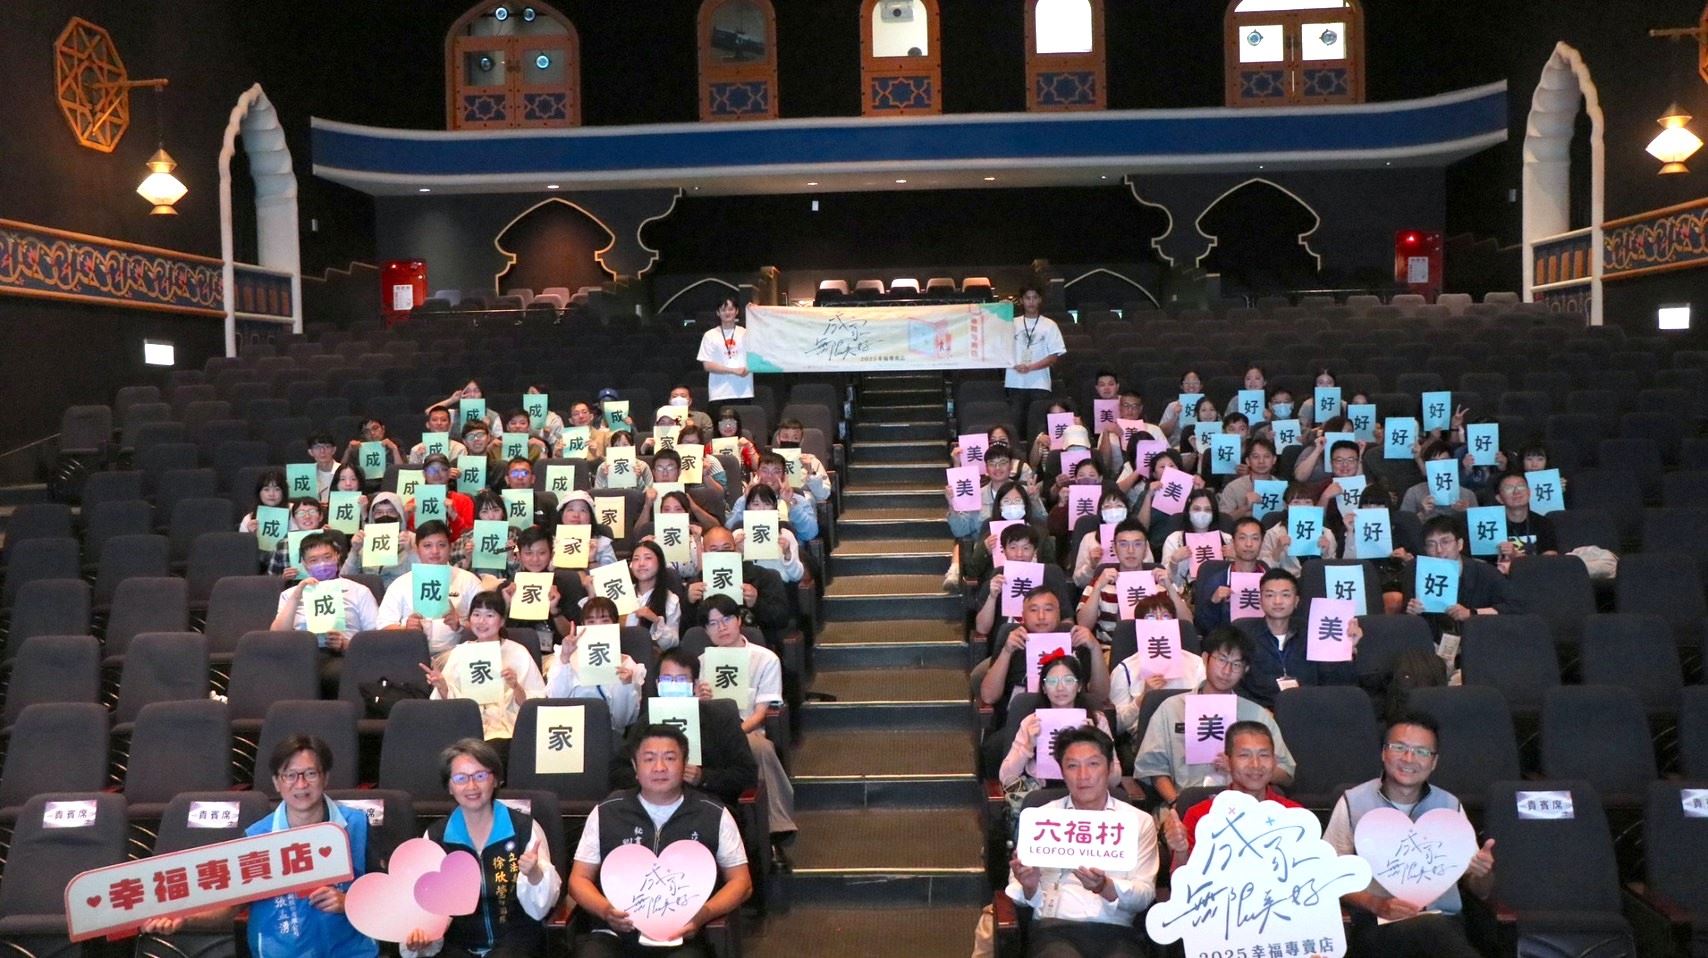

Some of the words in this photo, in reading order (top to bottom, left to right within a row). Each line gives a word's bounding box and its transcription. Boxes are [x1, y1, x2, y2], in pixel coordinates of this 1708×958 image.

[529, 404, 543, 418] 成
[1244, 401, 1259, 415] 好
[1320, 397, 1335, 411] 好
[1429, 402, 1445, 418] 好
[466, 409, 480, 421] 成
[611, 410, 624, 423] 成
[1100, 409, 1114, 423] 美
[1355, 415, 1370, 430] 好
[569, 436, 585, 451] 成
[660, 436, 674, 449] 家
[1280, 429, 1295, 443] 好
[1391, 429, 1409, 446] 好
[1475, 435, 1492, 452] 好
[508, 443, 522, 457] 成
[966, 445, 983, 462] 美
[1218, 446, 1234, 461] 好
[366, 452, 380, 466] 成
[613, 457, 630, 474] 家
[681, 455, 696, 470] 家
[294, 475, 310, 492] 成
[464, 467, 479, 483] 成
[552, 476, 567, 491] 成
[1435, 472, 1453, 490] 好
[956, 479, 974, 497] 美
[1163, 481, 1184, 502] 美
[1535, 483, 1554, 501] 好
[422, 497, 439, 514] 成
[1261, 493, 1279, 510] 好
[1343, 489, 1361, 505] 好
[336, 503, 354, 520] 成
[510, 500, 527, 517] 成
[1076, 498, 1095, 515] 美
[601, 509, 618, 526] 家
[262, 520, 280, 537] 成
[662, 526, 681, 546] 家
[752, 524, 771, 543] 家
[1296, 520, 1315, 540] 好
[1364, 523, 1383, 542] 好
[1477, 521, 1498, 541] 好
[371, 534, 390, 552] 成
[481, 534, 500, 553] 成
[563, 538, 582, 555] 家
[1195, 544, 1215, 563] 美
[712, 568, 734, 589] 家
[1425, 573, 1448, 597] 好
[420, 580, 442, 601] 成
[521, 583, 542, 604] 家
[603, 578, 626, 601] 家
[1011, 577, 1032, 598] 美
[1335, 580, 1356, 600] 好
[314, 595, 336, 616] 成
[1240, 588, 1260, 609] 美
[1319, 616, 1343, 641] 美
[587, 641, 611, 666] 家
[1148, 636, 1172, 660] 美
[469, 659, 494, 684] 家
[715, 664, 738, 689] 家
[1197, 714, 1224, 741] 美
[548, 724, 573, 751] 家
[1033, 819, 1125, 846] 六福村
[1029, 847, 1075, 858] LEOFOO
[1079, 849, 1125, 858] VILLAGE
[1202, 811, 1321, 883] 成家
[108, 842, 315, 912] 幸福專賣店
